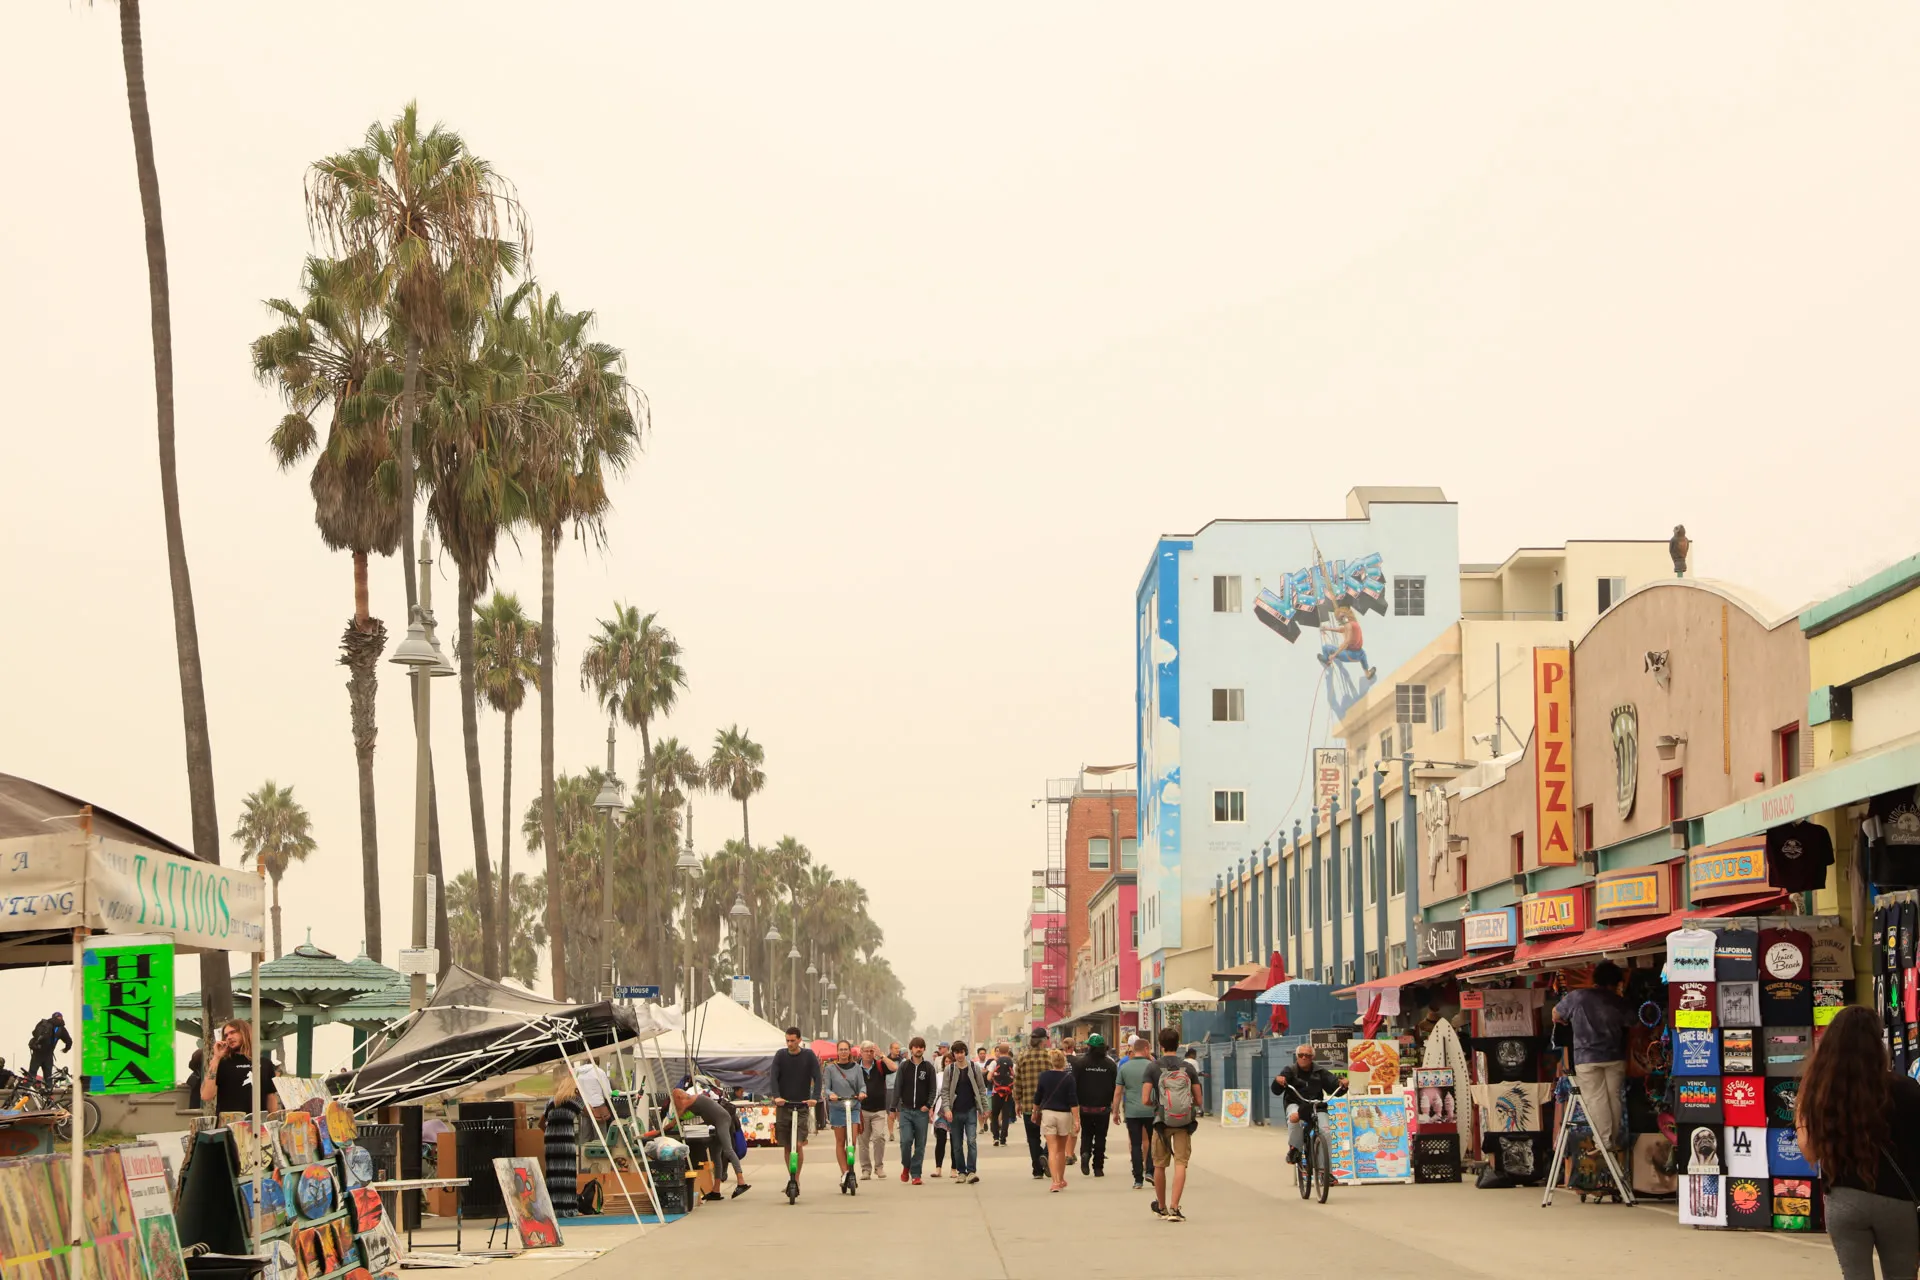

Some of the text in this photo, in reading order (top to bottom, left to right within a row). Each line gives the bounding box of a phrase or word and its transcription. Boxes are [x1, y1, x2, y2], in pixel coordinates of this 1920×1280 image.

[1254, 551, 1384, 625] VENICE
[1319, 752, 1337, 765] The
[1542, 662, 1568, 852] PIZZA
[1761, 794, 1796, 822] MORADO
[11, 851, 29, 872] A
[133, 854, 230, 938] TATTOOS
[1525, 900, 1559, 925] PIZZA
[1426, 928, 1457, 957] GALLERY
[1771, 952, 1794, 962] Venice
[1772, 961, 1801, 971] Beach
[615, 986, 649, 994] Club House
[1679, 982, 1708, 992] VENICE
[1764, 982, 1784, 991] VENICE
[1784, 982, 1804, 991] BEACH
[98, 953, 157, 1088] HENNA
[1678, 1030, 1714, 1043] VENICE BEACH
[1680, 1086, 1717, 1104] BEACH
[1725, 1080, 1756, 1097] LIFEGUARD
[1732, 1126, 1752, 1153] LA
